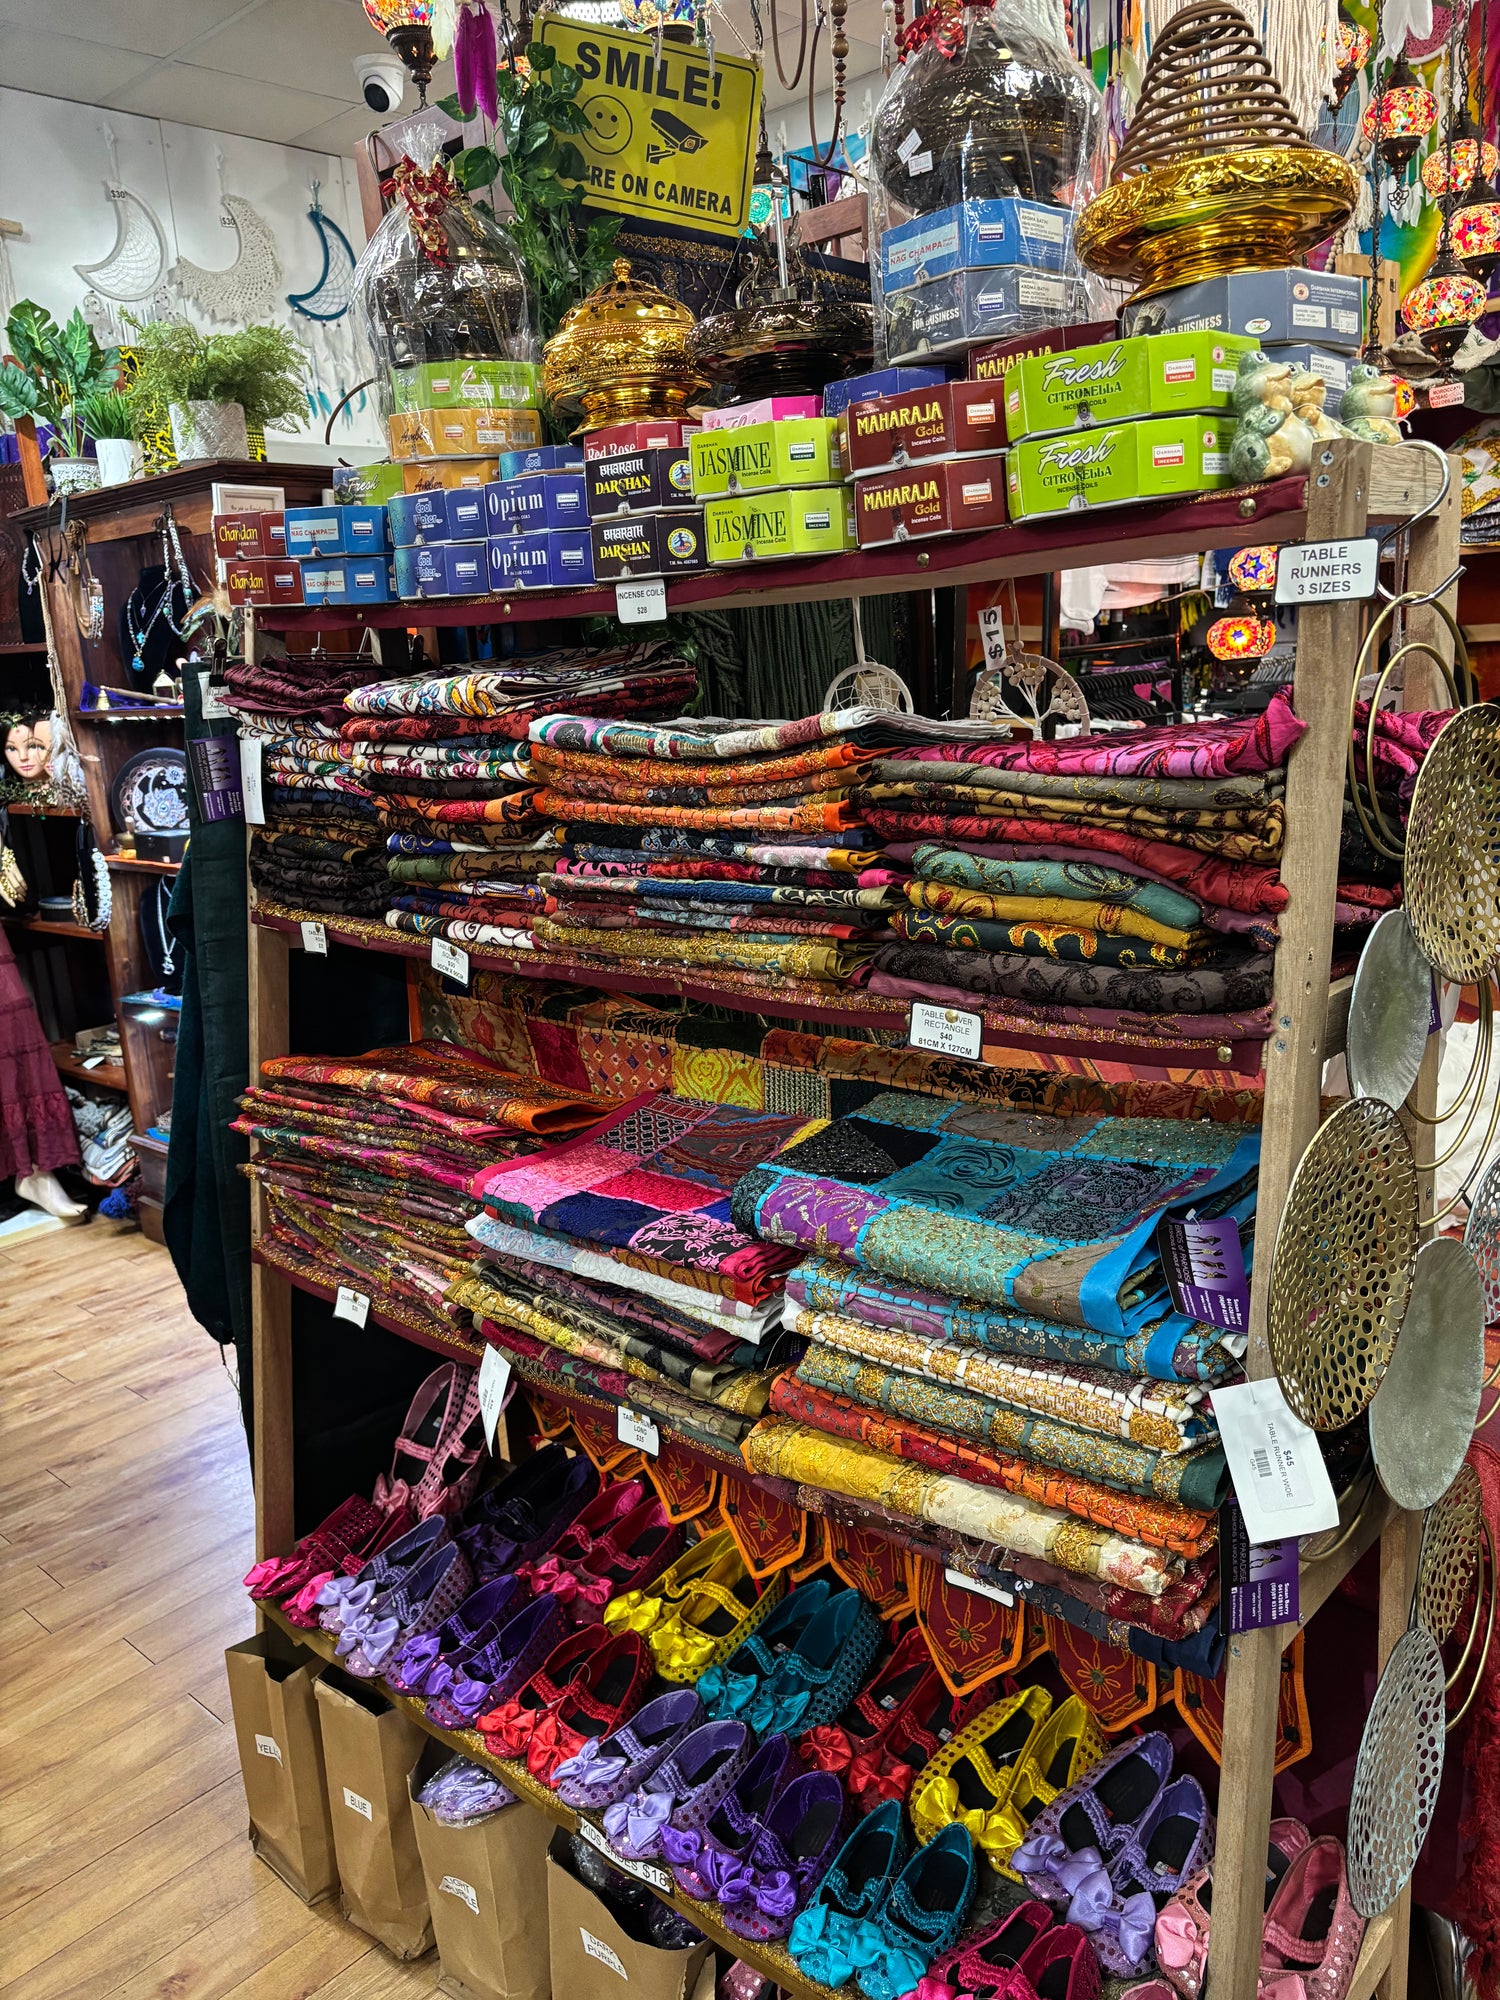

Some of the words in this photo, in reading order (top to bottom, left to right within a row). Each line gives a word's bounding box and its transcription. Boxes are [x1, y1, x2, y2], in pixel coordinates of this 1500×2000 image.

[575, 41, 723, 110] SMILE!
[622, 173, 648, 198] ON
[654, 180, 733, 216] CAMERA
[890, 254, 907, 267] NAG
[908, 240, 943, 260] CHAMPA
[976, 352, 998, 363] DARSHAN
[1041, 344, 1127, 393] Fresh
[1165, 363, 1195, 373] DARSHAN
[1168, 372, 1194, 382] INCENSE
[1047, 380, 1123, 405] CITRONELLA
[968, 406, 995, 416] DARSHAN
[1088, 398, 1107, 407] COILS
[855, 407, 881, 417] DARSHAN
[856, 401, 944, 436] MAHARAJA
[971, 415, 992, 423] INCENSE
[915, 421, 944, 438] Gold
[696, 441, 718, 449] DARSHAN
[911, 439, 931, 447] Incense
[931, 435, 946, 444] Coils
[587, 446, 606, 460] Red
[609, 443, 636, 456] Rose
[792, 452, 813, 460] INCENSE
[1038, 430, 1117, 470] Fresh
[1154, 447, 1184, 457] DARSHAN
[698, 441, 771, 477] JASMINE
[1157, 456, 1182, 466] INCENSE
[741, 470, 761, 478] Incense
[761, 468, 772, 476] Coils
[1042, 464, 1113, 488] CITRONELLA
[348, 475, 378, 492] Fresh
[595, 474, 651, 497] DARSHAN
[863, 484, 885, 493] DARSHAN
[964, 487, 991, 495] DARSHAN
[863, 480, 940, 512] MAHARAJA
[966, 494, 988, 502] INCENSE
[415, 500, 432, 513] Cool
[489, 490, 543, 520] Opium
[914, 501, 941, 516] Gold
[714, 510, 786, 544] JASMINE
[808, 521, 828, 529] INCENSE
[911, 516, 930, 524] Incense
[930, 514, 942, 523] Coils
[219, 524, 258, 542] Chandan
[418, 554, 432, 566] Cool
[491, 545, 547, 575] Opium
[600, 540, 651, 563] DARSHAN
[1301, 546, 1348, 561] TABLE
[1290, 562, 1361, 580] RUNNERS
[230, 572, 264, 590] Chandan
[1297, 584, 1306, 595] 3
[1309, 580, 1351, 594] SIZES
[617, 589, 645, 600] INCENSE
[646, 587, 665, 598] COILS
[636, 605, 648, 615] $28
[982, 609, 1005, 660] $15
[920, 1008, 945, 1020] TABLE
[957, 1016, 973, 1026] VER
[924, 1019, 970, 1036] RECTANGLE
[939, 1032, 953, 1041] $40
[918, 1037, 939, 1048] 81CM
[940, 1042, 946, 1050] X
[948, 1044, 972, 1056] 127CM
[1180, 1253, 1192, 1284] PARADISE
[634, 1425, 648, 1436] LONG
[1267, 1422, 1278, 1446] TABLE
[1274, 1446, 1288, 1478] RUNNER
[1282, 1478, 1293, 1498] WIDE
[1283, 1449, 1295, 1467] $45
[350, 1795, 368, 1813] BLUE
[582, 1822, 602, 1846] KIDS
[642, 1864, 666, 1887] $18
[587, 1943, 626, 1975] PURPLE
